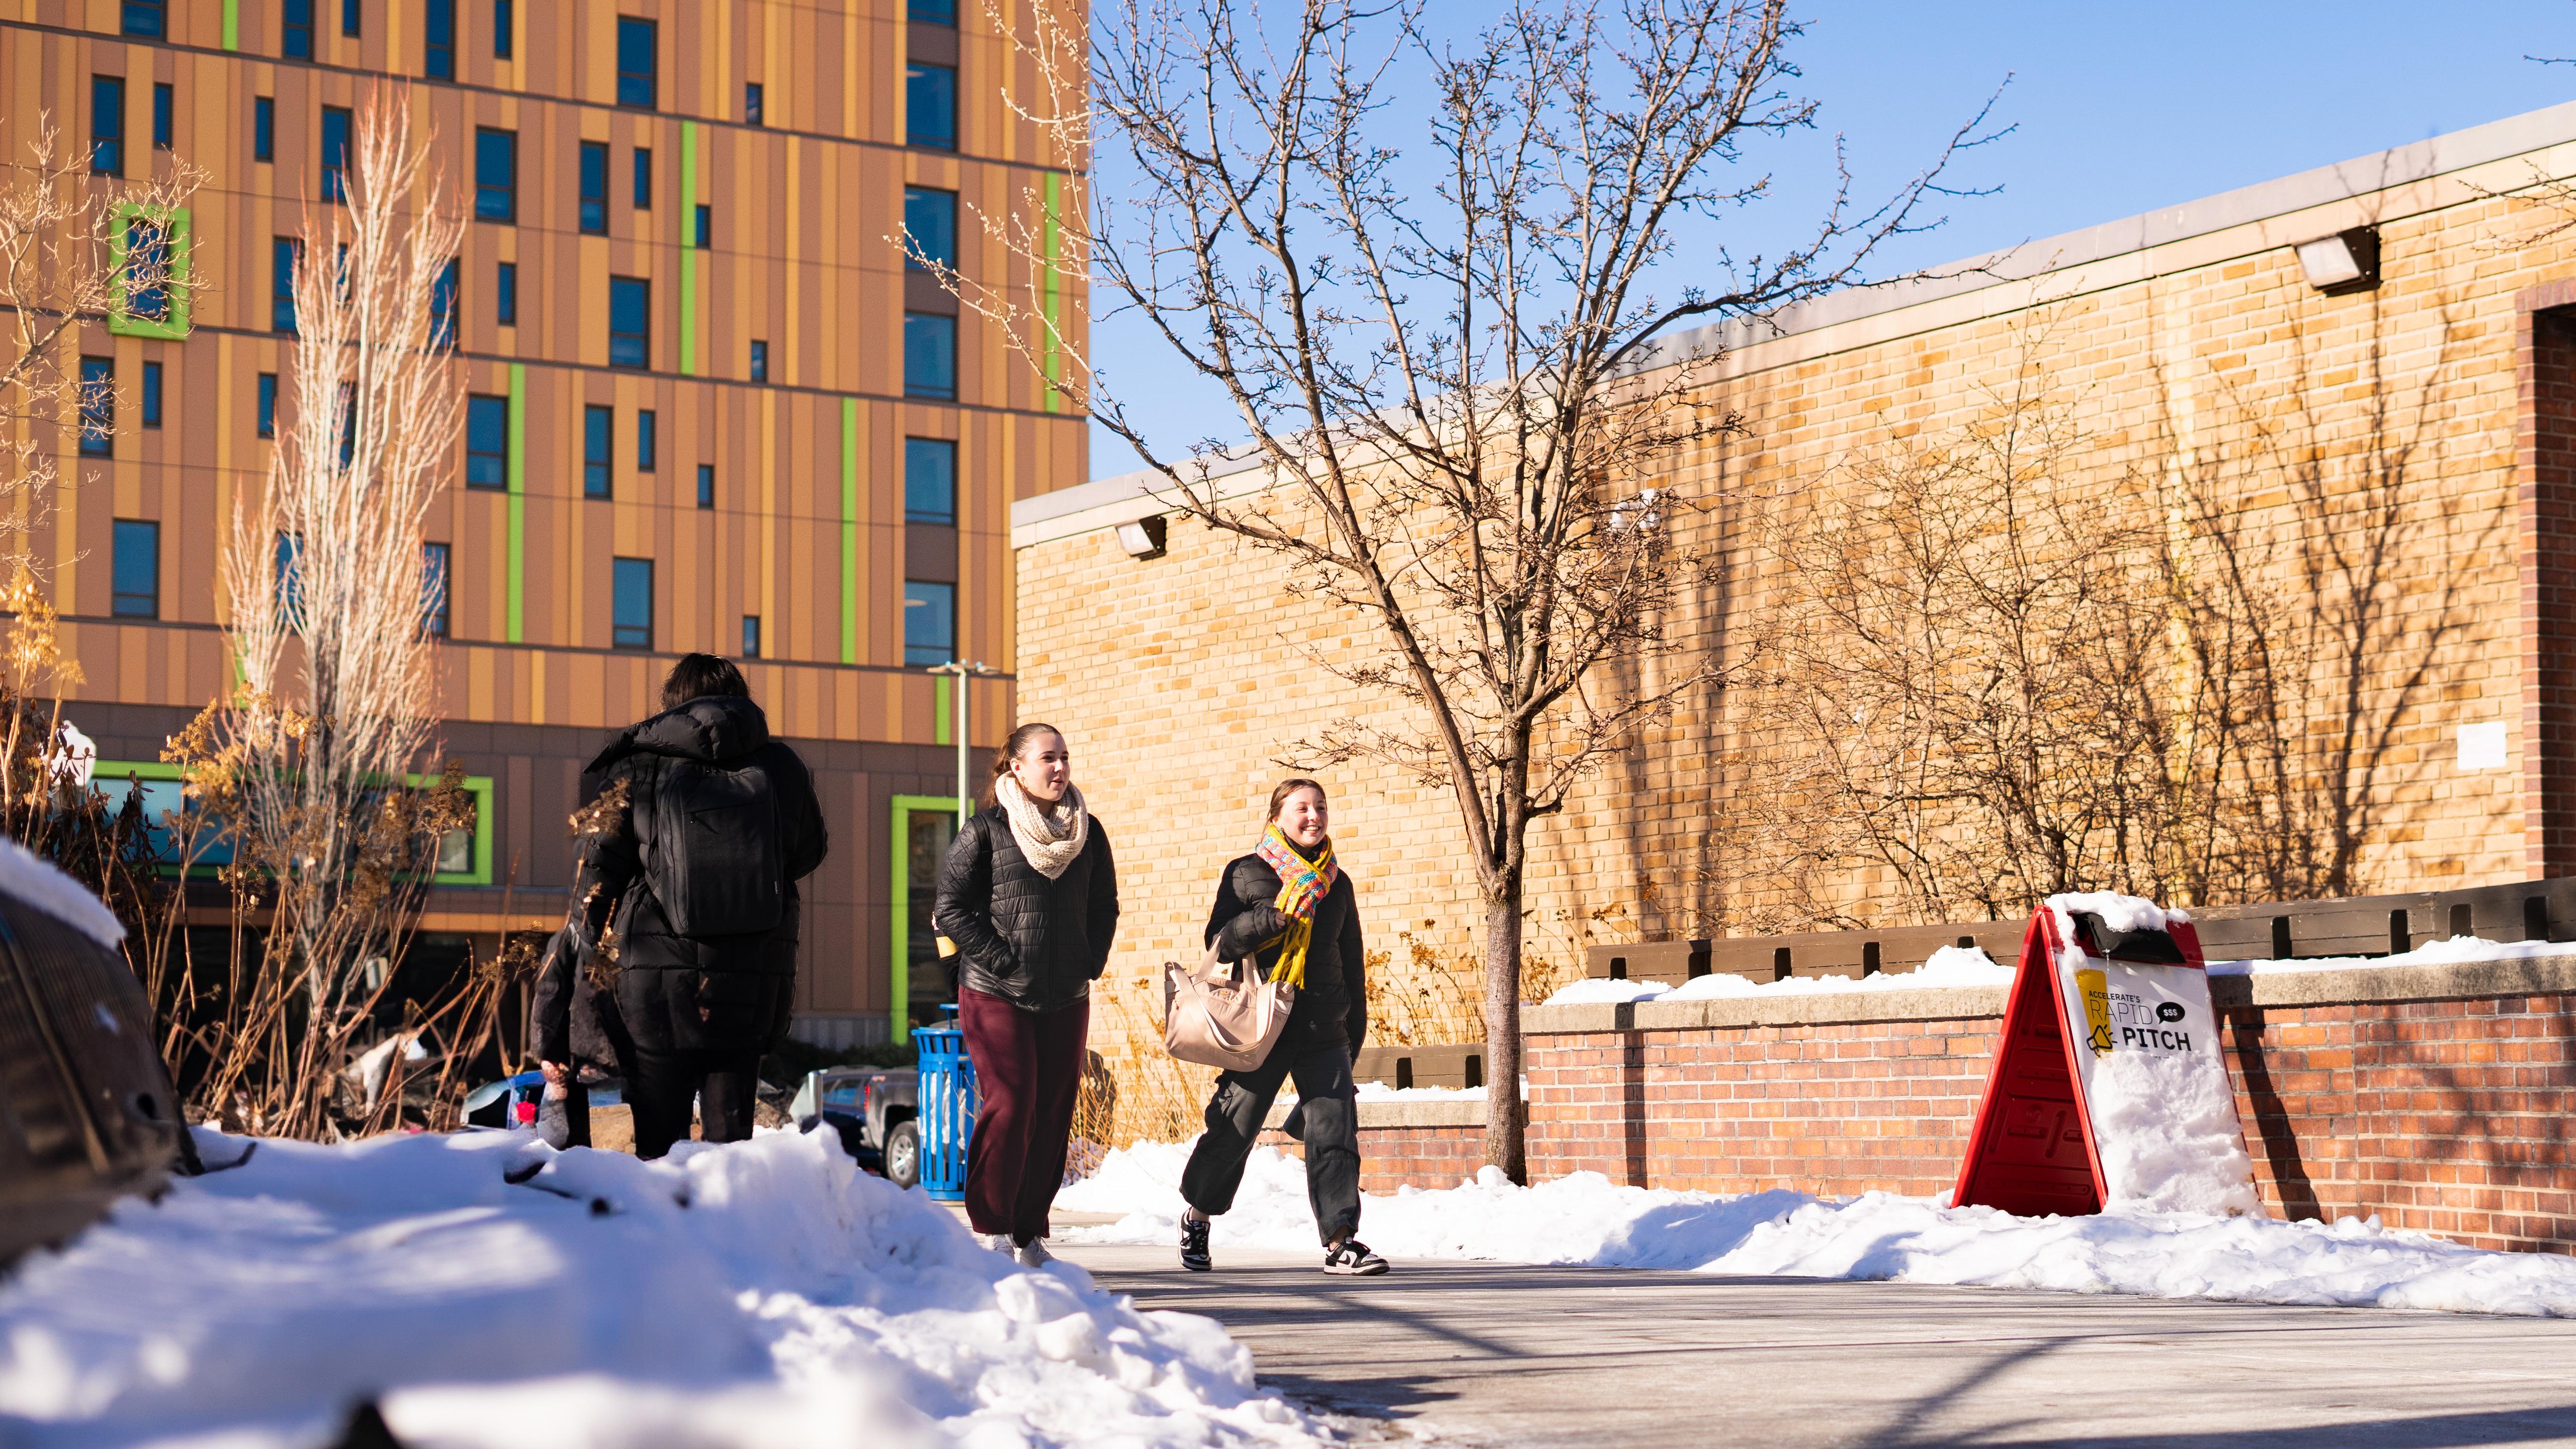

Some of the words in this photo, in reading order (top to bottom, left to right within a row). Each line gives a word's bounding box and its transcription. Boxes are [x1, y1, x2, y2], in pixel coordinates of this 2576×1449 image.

[2089, 990, 2140, 1003] ACCELERATE'S
[2090, 999, 2153, 1025] RAPID
[2122, 1027, 2191, 1051] PITCH
